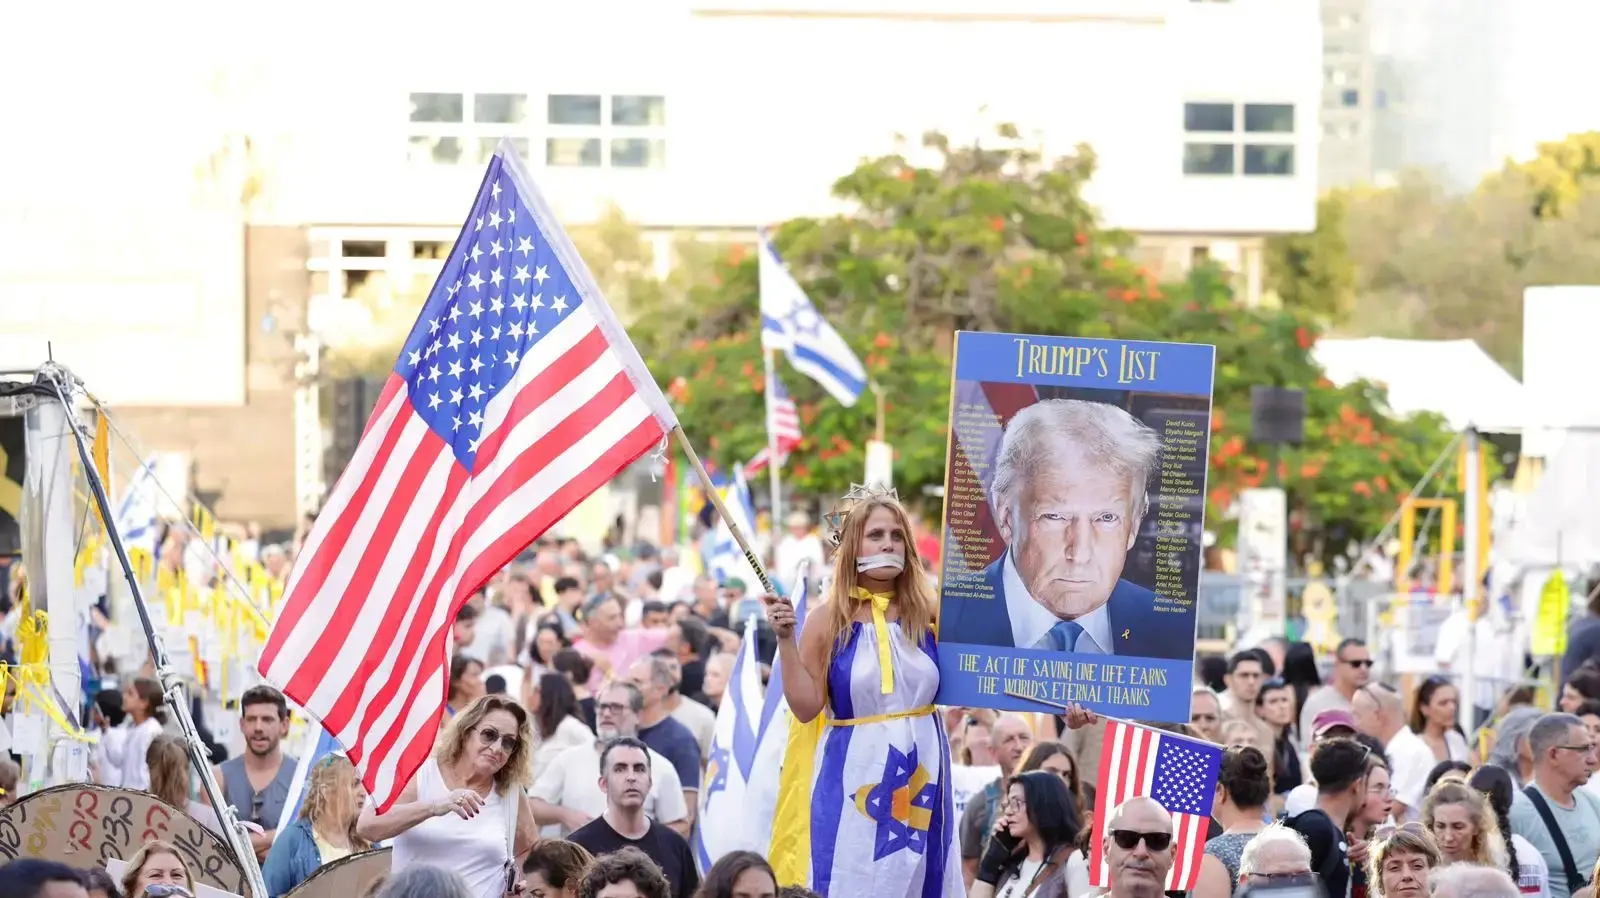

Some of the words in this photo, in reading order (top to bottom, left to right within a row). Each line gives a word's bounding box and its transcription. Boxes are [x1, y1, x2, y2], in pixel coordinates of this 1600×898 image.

[958, 654, 980, 672] THE
[985, 656, 1009, 674] ACT
[1013, 658, 1029, 675] OF
[1033, 660, 1072, 681] SAVING
[1076, 663, 1097, 681] ONE
[1102, 665, 1126, 683] LIFE
[1130, 668, 1167, 686] EARNS
[977, 676, 999, 695] THE
[1004, 678, 1047, 698] WORLD'S
[1052, 683, 1102, 703] ETERNAL
[1106, 686, 1150, 706] THANKS
